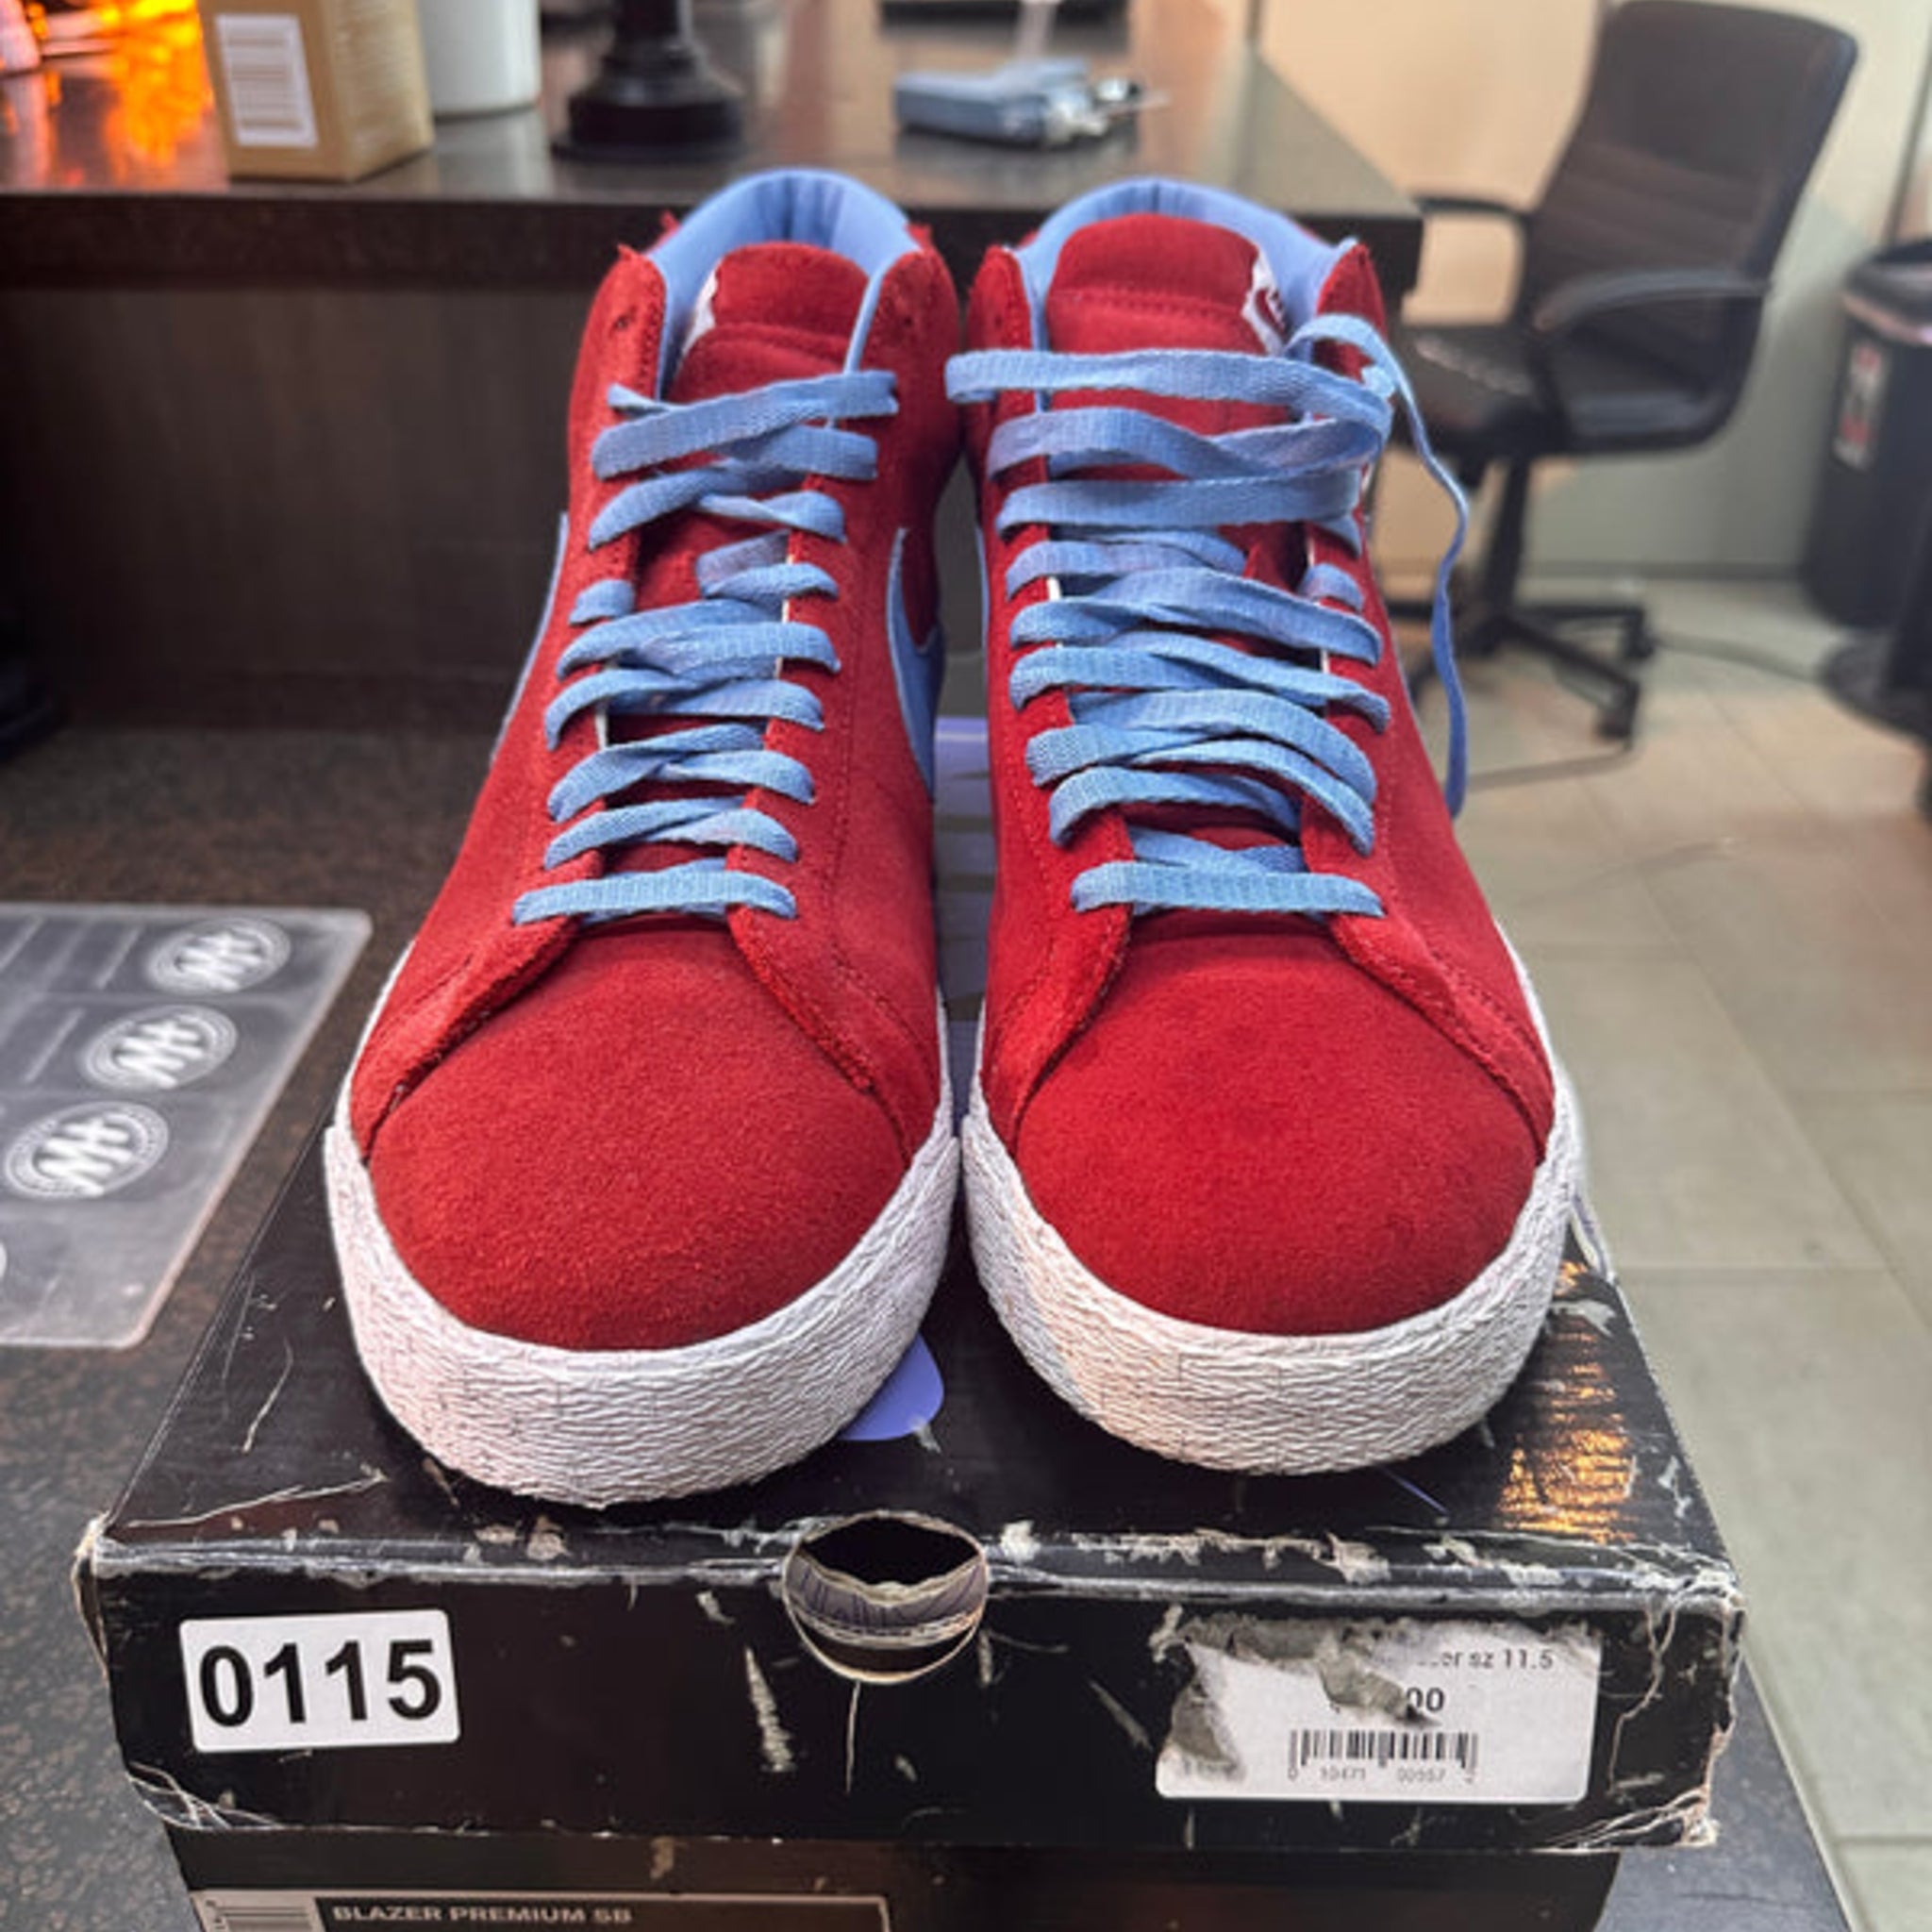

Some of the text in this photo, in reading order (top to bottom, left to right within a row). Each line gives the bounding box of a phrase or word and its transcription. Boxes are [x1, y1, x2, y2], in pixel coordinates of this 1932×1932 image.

[1468, 1651, 1494, 1669] sz
[1504, 1648, 1554, 1670] 11.5
[199, 1640, 442, 1727] 0115
[333, 1905, 633, 1924] BLAZER PREMIUM SB
